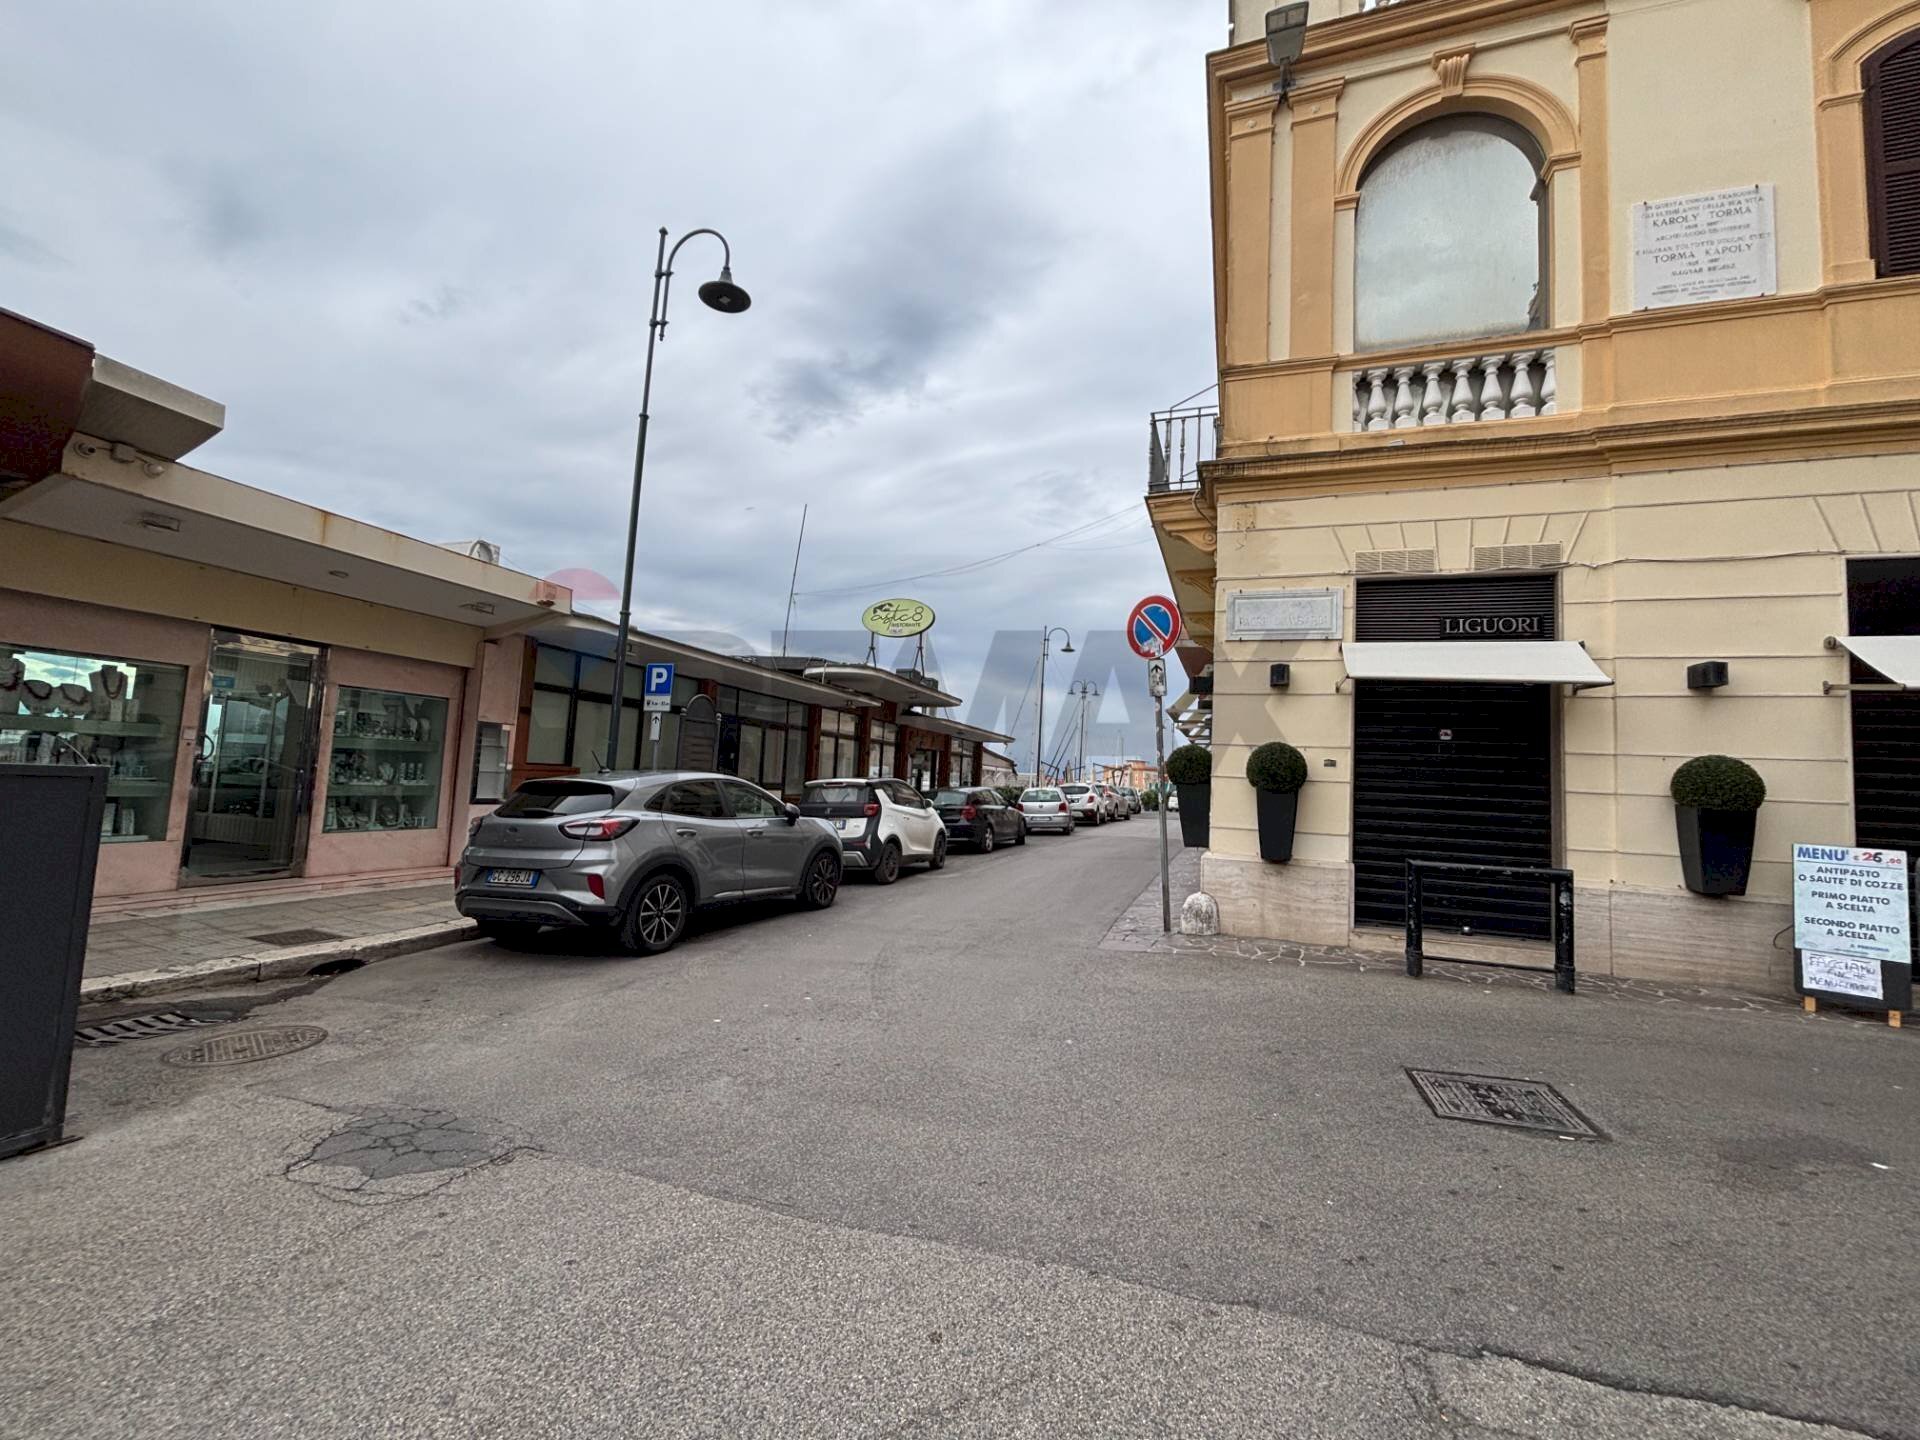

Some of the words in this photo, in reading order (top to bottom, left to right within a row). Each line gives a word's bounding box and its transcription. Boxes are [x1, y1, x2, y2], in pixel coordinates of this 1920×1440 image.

[1709, 205, 1751, 218] TORMA
[1654, 250, 1694, 263] TORMA
[1444, 616, 1541, 635] LIGUORI
[650, 667, 668, 692] P
[1816, 866, 1880, 878] ANTIPASTO
[1850, 879, 1862, 887] DI
[1865, 880, 1904, 890] COZZE
[1811, 891, 1847, 901] PRIMO
[1850, 895, 1890, 905] PIATTO
[1825, 901, 1834, 909] A
[1837, 902, 1875, 913] SCELTA
[1804, 916, 1856, 929] SECONDO
[1859, 923, 1900, 935] PIATTO
[1837, 930, 1877, 941] SCELTA
